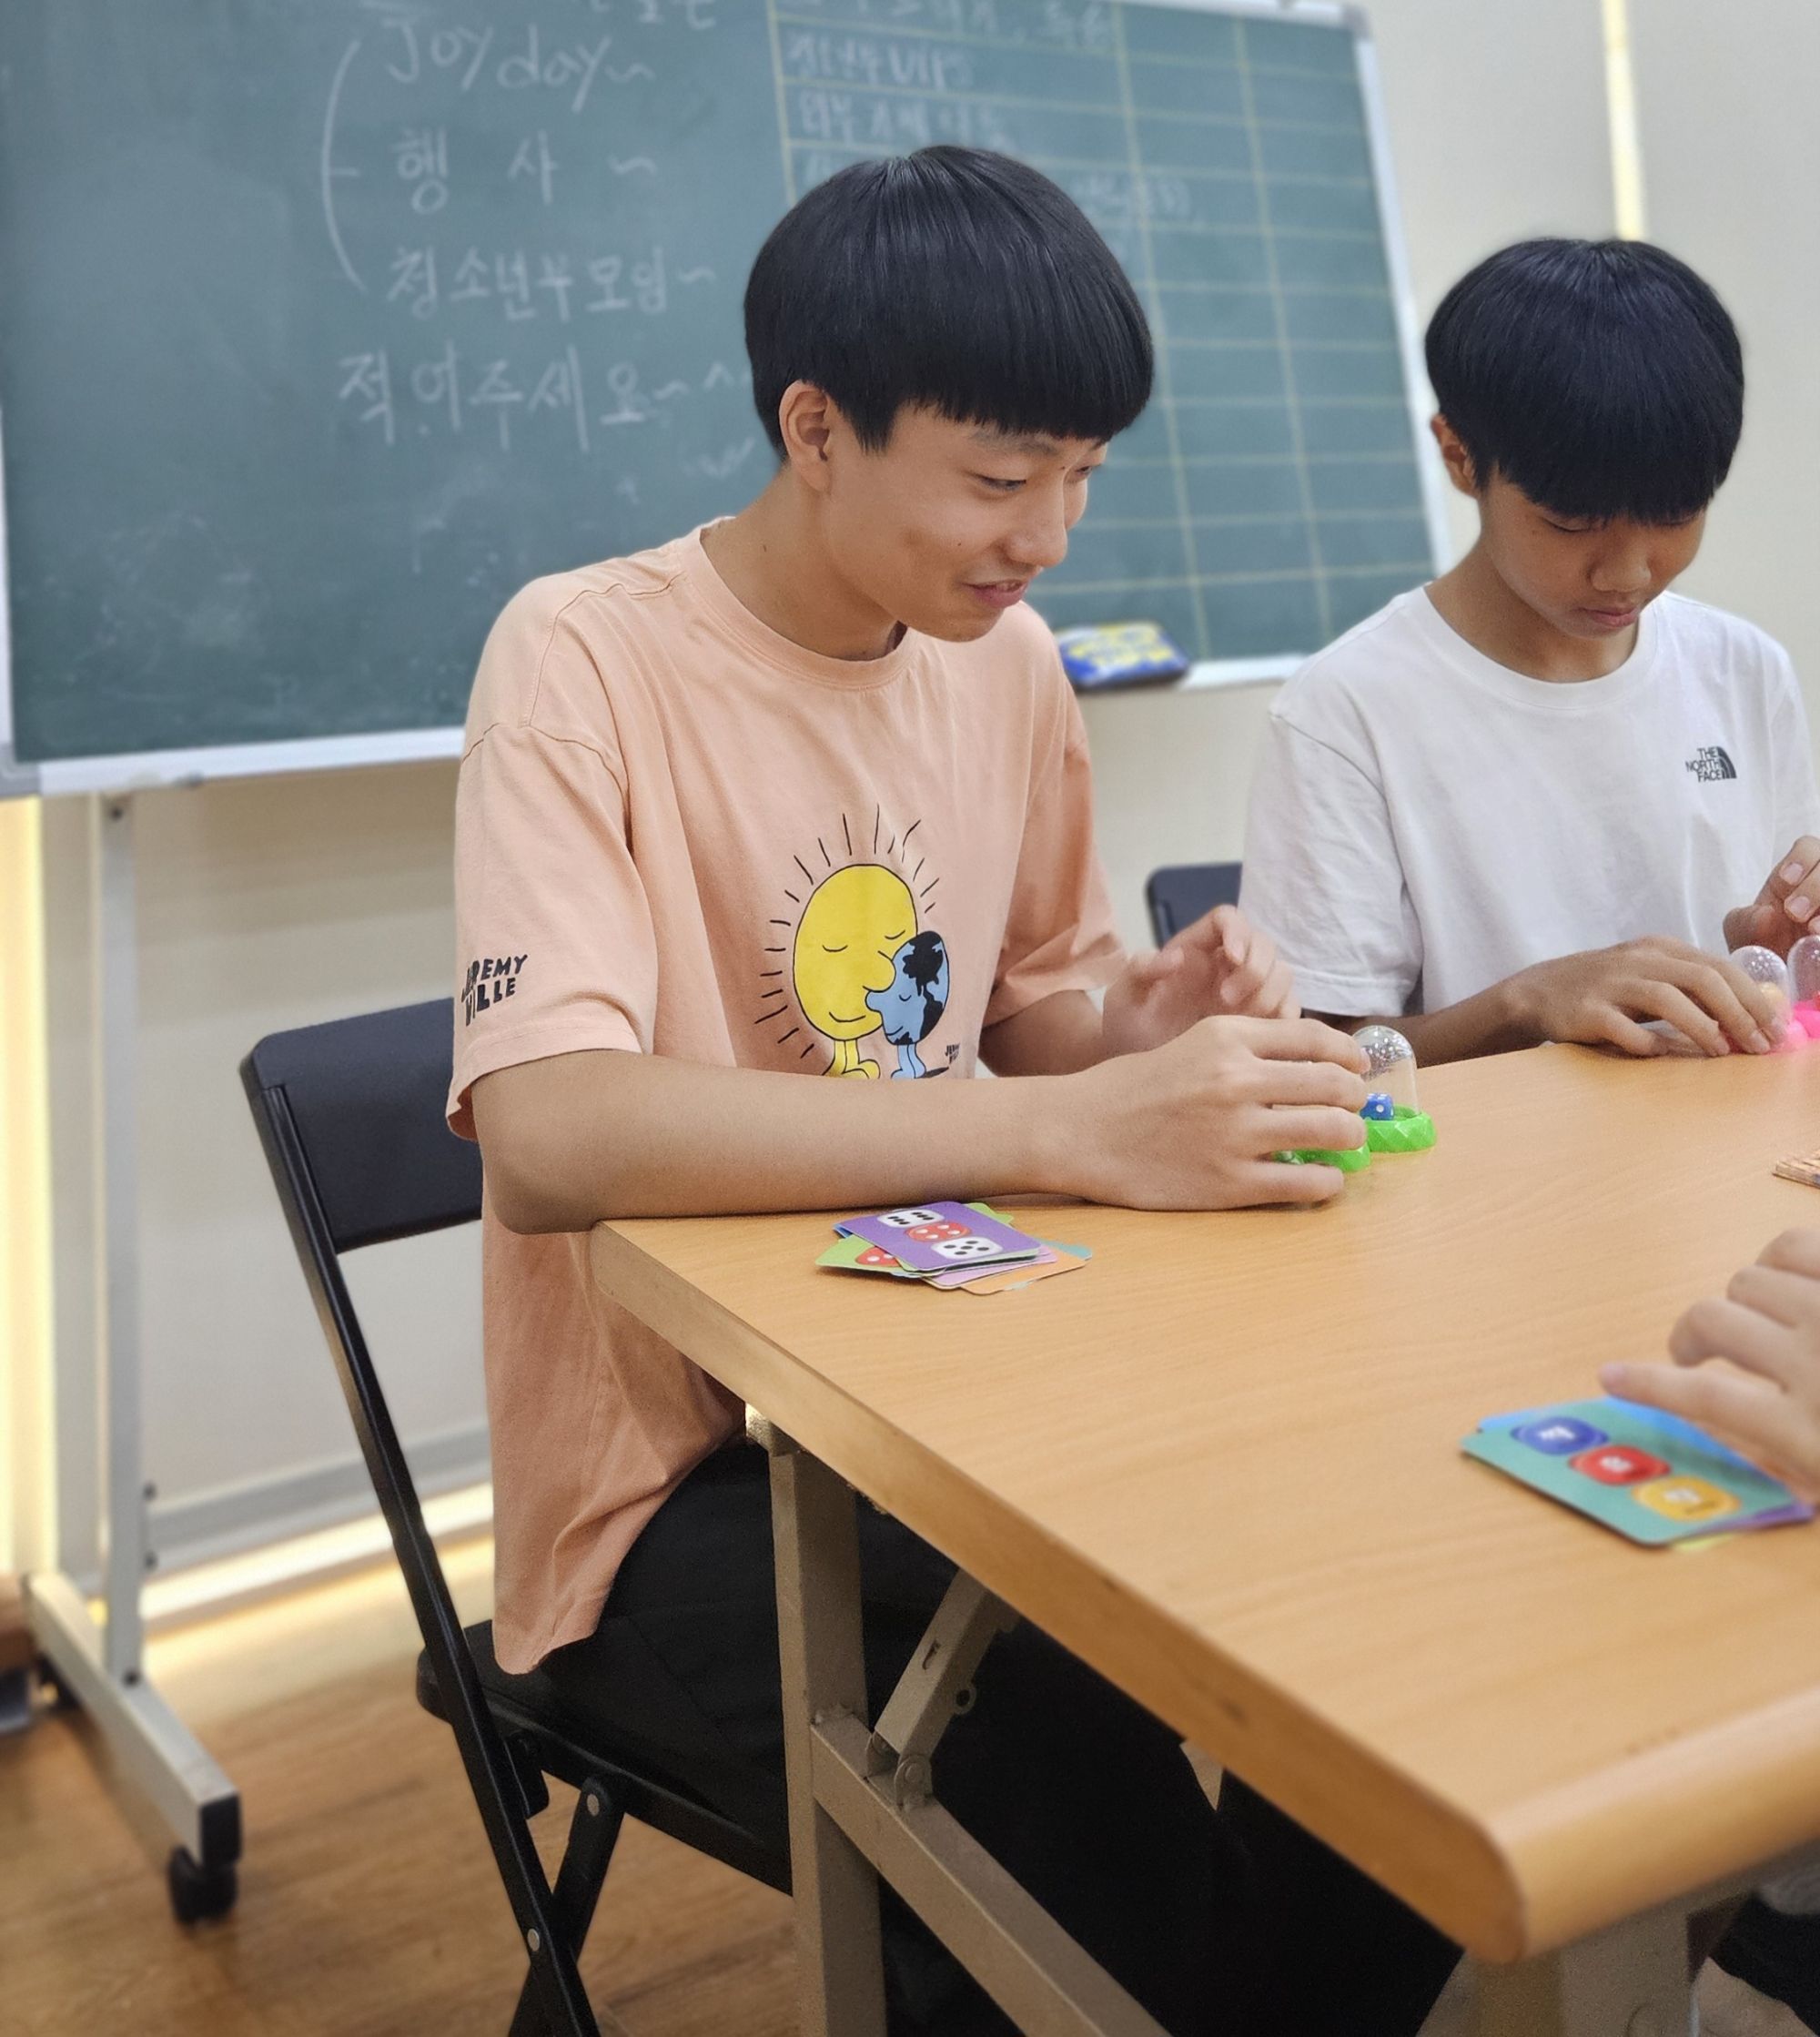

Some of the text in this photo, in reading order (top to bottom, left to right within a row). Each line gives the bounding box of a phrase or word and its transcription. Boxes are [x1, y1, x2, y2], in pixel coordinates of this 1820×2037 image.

[1696, 746, 1718, 761] THE
[1684, 758, 1720, 772] NORTH
[1697, 769, 1722, 783] FACE
